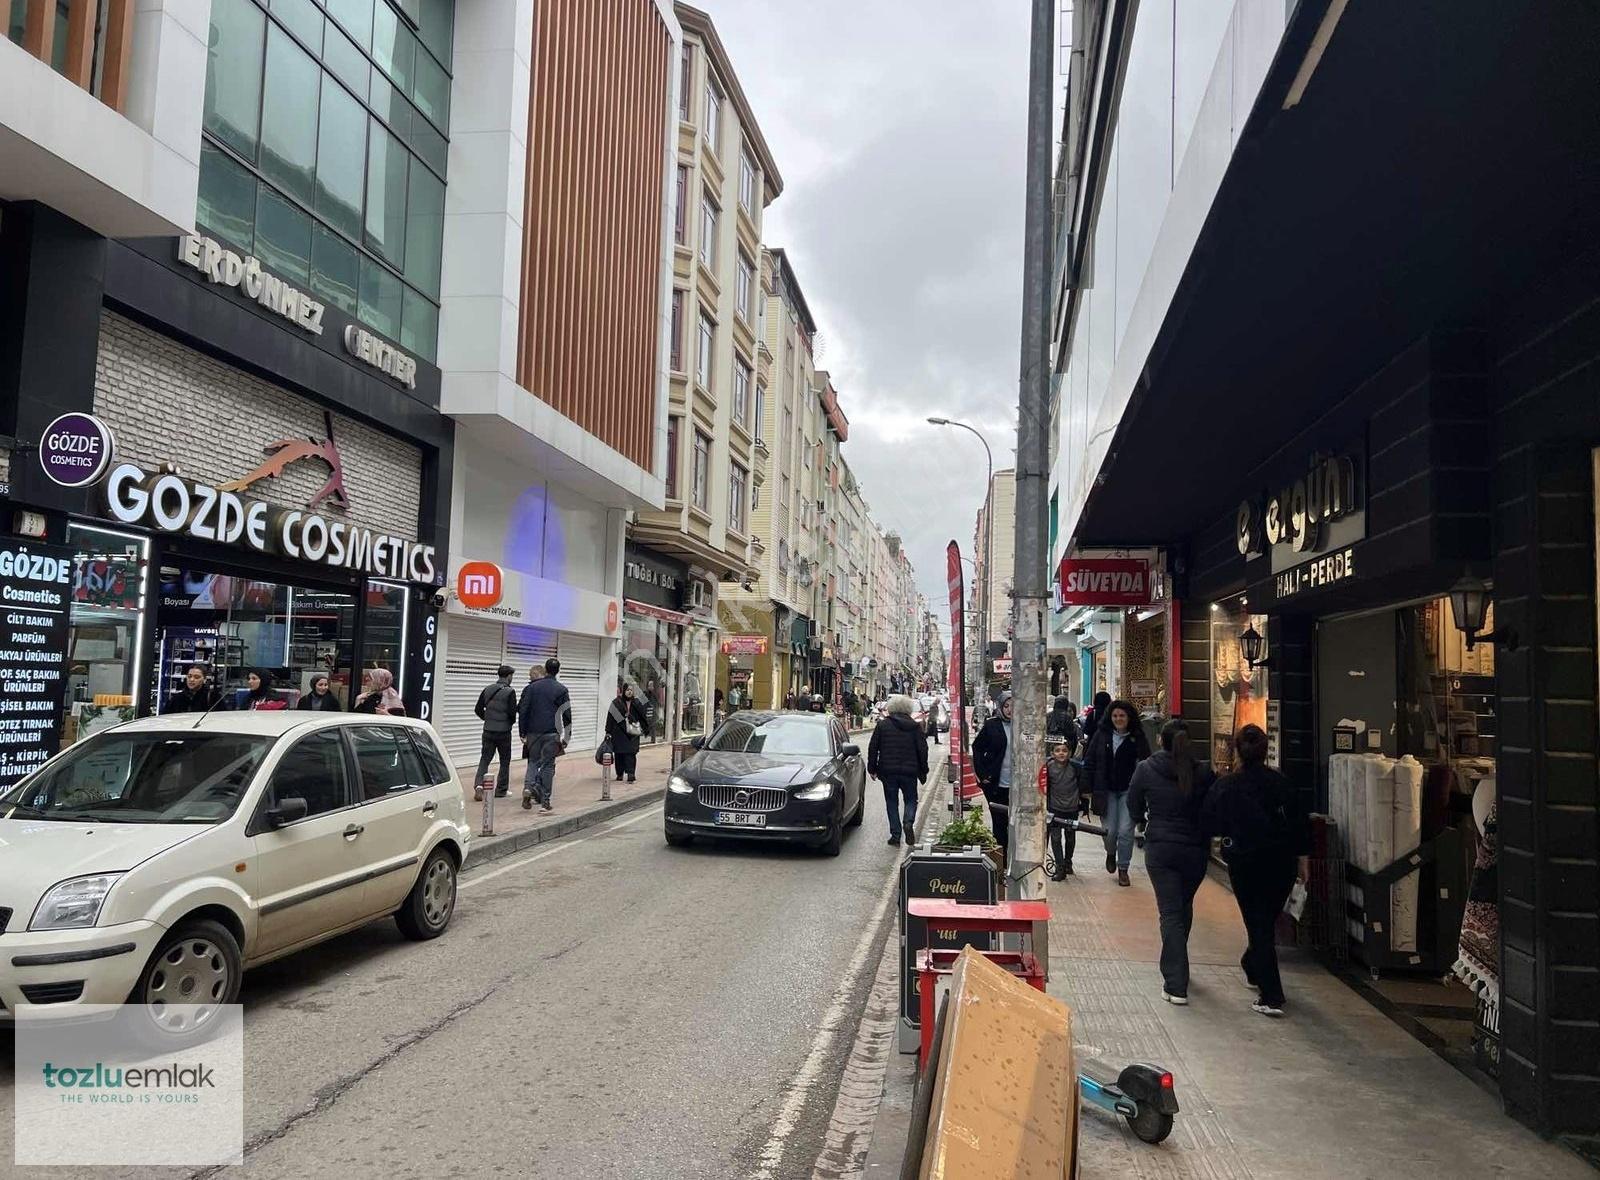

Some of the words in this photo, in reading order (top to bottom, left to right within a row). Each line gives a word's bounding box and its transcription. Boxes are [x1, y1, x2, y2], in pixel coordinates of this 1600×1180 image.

[178, 233, 325, 336] ERDÖNMEZ
[345, 324, 417, 390] CENTER
[48, 431, 99, 453] GÖZDE
[50, 455, 92, 467] COSMETICS
[107, 462, 268, 551] GÖZDE
[282, 511, 435, 584] COSMETICS
[0, 547, 70, 583] GÖZDE
[628, 562, 657, 585] TUĞBA
[1066, 569, 1144, 593] SÜVEYDA
[3, 585, 60, 604] Cosmetics
[7, 612, 24, 624] CİLT
[26, 615, 53, 627] BAKIM
[11, 631, 45, 644] PARFÜM
[25, 650, 62, 662] ÜRÜNLERİ
[15, 669, 32, 681] SAÇ
[33, 670, 60, 680] BAKIM
[4, 680, 45, 692] ÜRÜNLERİ
[26, 701, 54, 711] BAKIM
[23, 719, 54, 729] TIRNAK
[0, 730, 41, 743] ÜRÜNLERİ
[16, 749, 48, 761] KİRPİK
[720, 813, 730, 822] 55
[756, 816, 765, 825] 41
[929, 878, 967, 894] Perde
